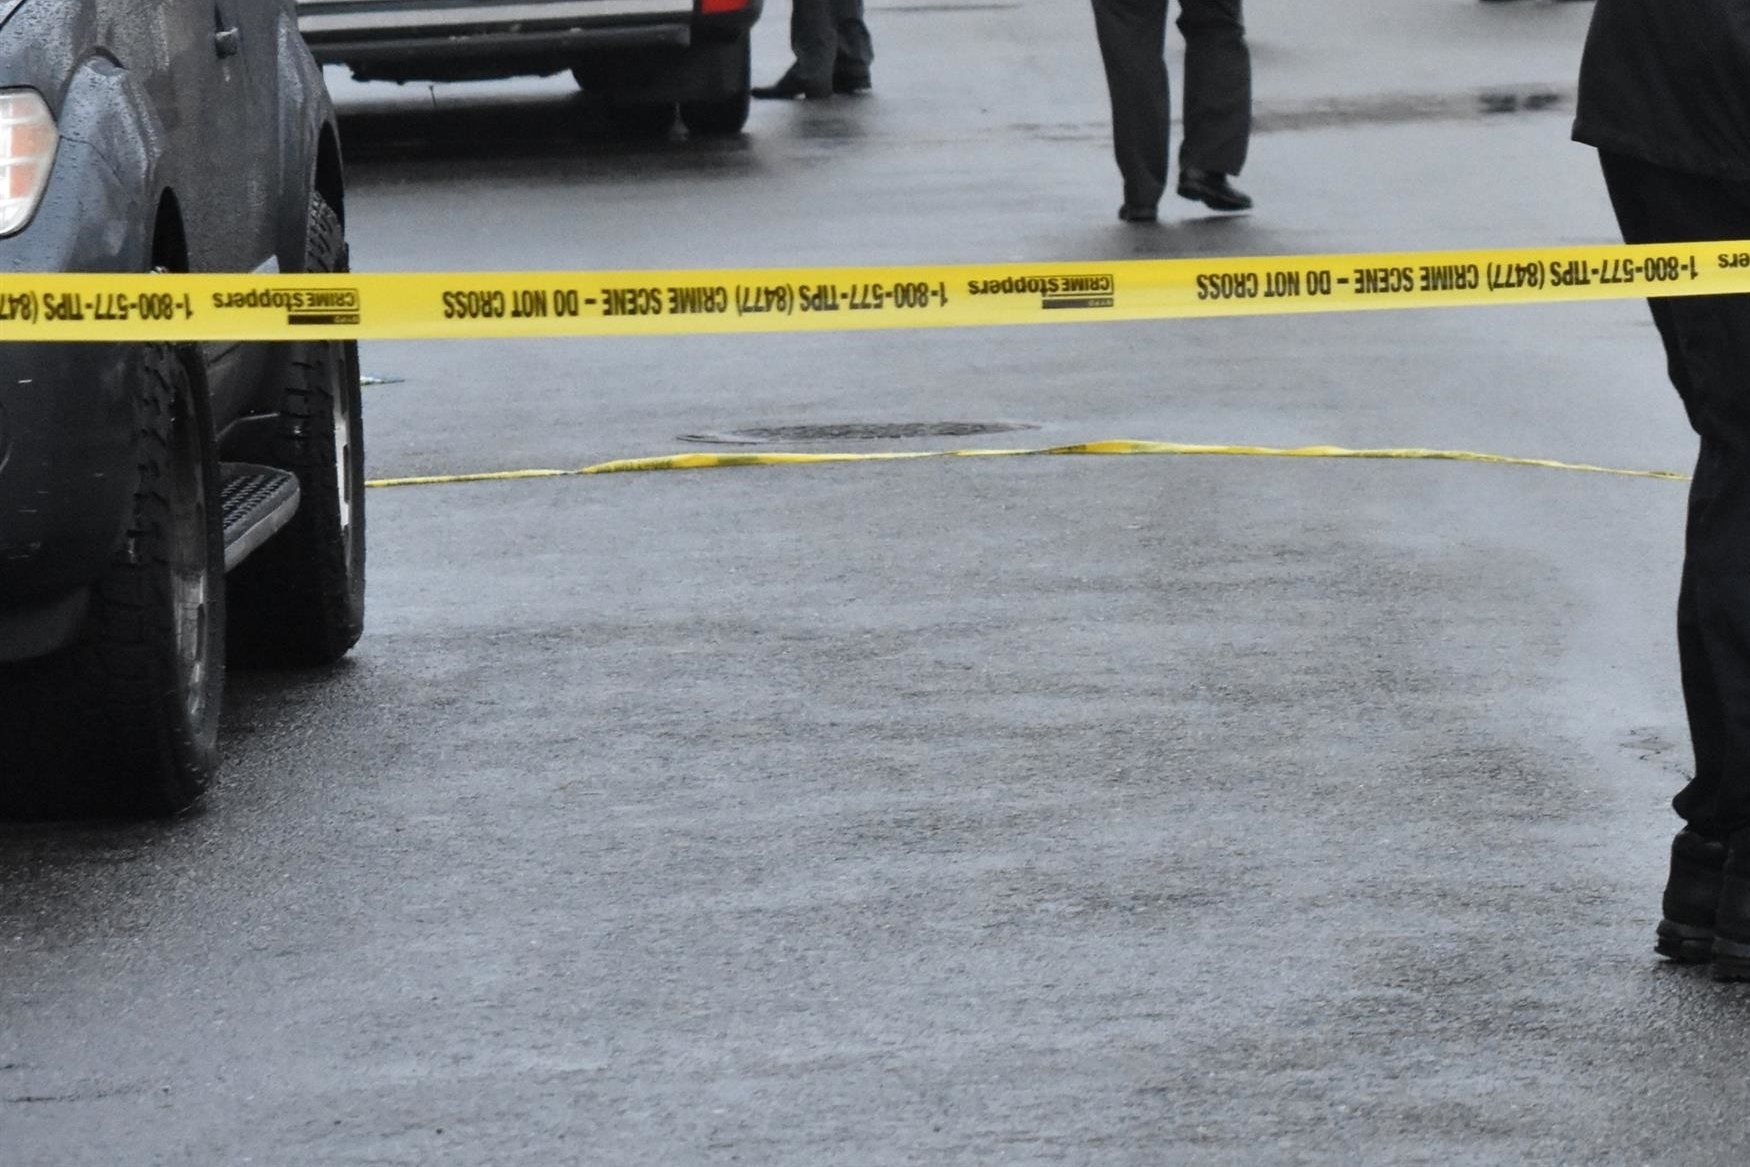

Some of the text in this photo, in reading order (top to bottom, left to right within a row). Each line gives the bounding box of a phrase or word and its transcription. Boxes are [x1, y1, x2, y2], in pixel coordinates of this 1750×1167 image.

[1264, 272, 1300, 297] NOT
[1306, 271, 1331, 295] DO
[1354, 267, 1413, 293] SCENE
[1420, 264, 1479, 291] CRIME
[1487, 261, 1545, 291] (8477)
[1550, 256, 1698, 286] 1-800-577-TIPS
[736, 284, 794, 315] (8477)
[799, 282, 948, 311] 1-800-577-TIPS
[1197, 273, 1258, 299] CROSS
[43, 293, 193, 321] 1-800-577-TIPS
[443, 291, 505, 319] CROSS
[511, 290, 547, 317] NOT
[553, 290, 578, 317] DO
[601, 288, 662, 316] SCENE
[667, 287, 728, 314] CRIME
